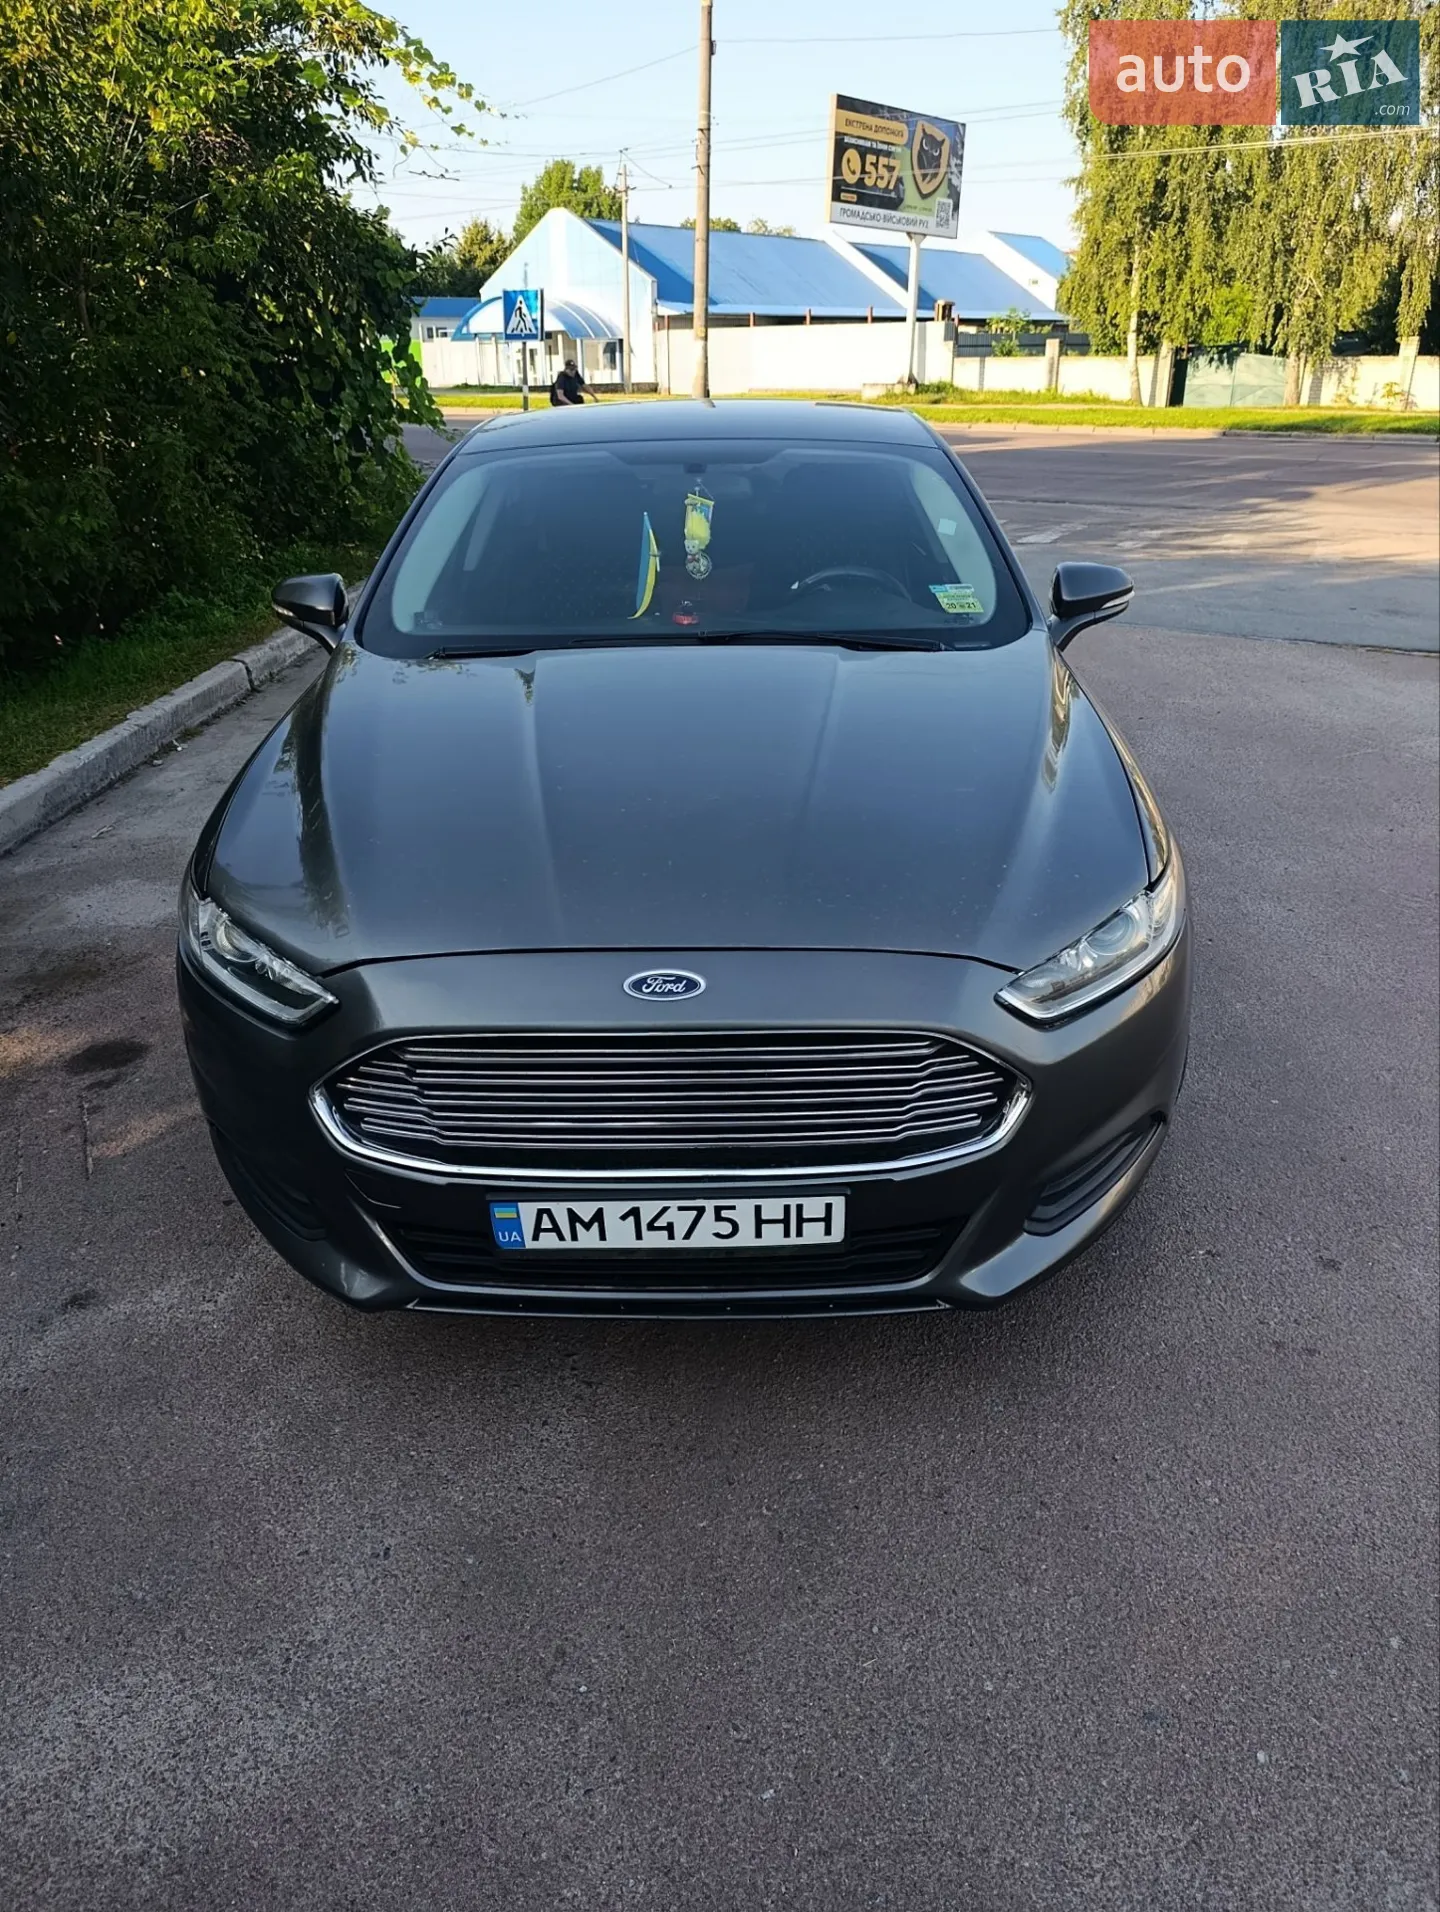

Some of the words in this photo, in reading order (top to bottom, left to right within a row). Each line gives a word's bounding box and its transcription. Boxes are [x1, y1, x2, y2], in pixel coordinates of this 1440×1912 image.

[845, 118, 873, 132] ЕКСТРЕНА
[864, 154, 901, 190] 557
[642, 976, 687, 993] Ford
[531, 1206, 607, 1243] AM
[619, 1204, 740, 1241] 1475
[754, 1202, 833, 1239] HH
[498, 1231, 521, 1243] UA
